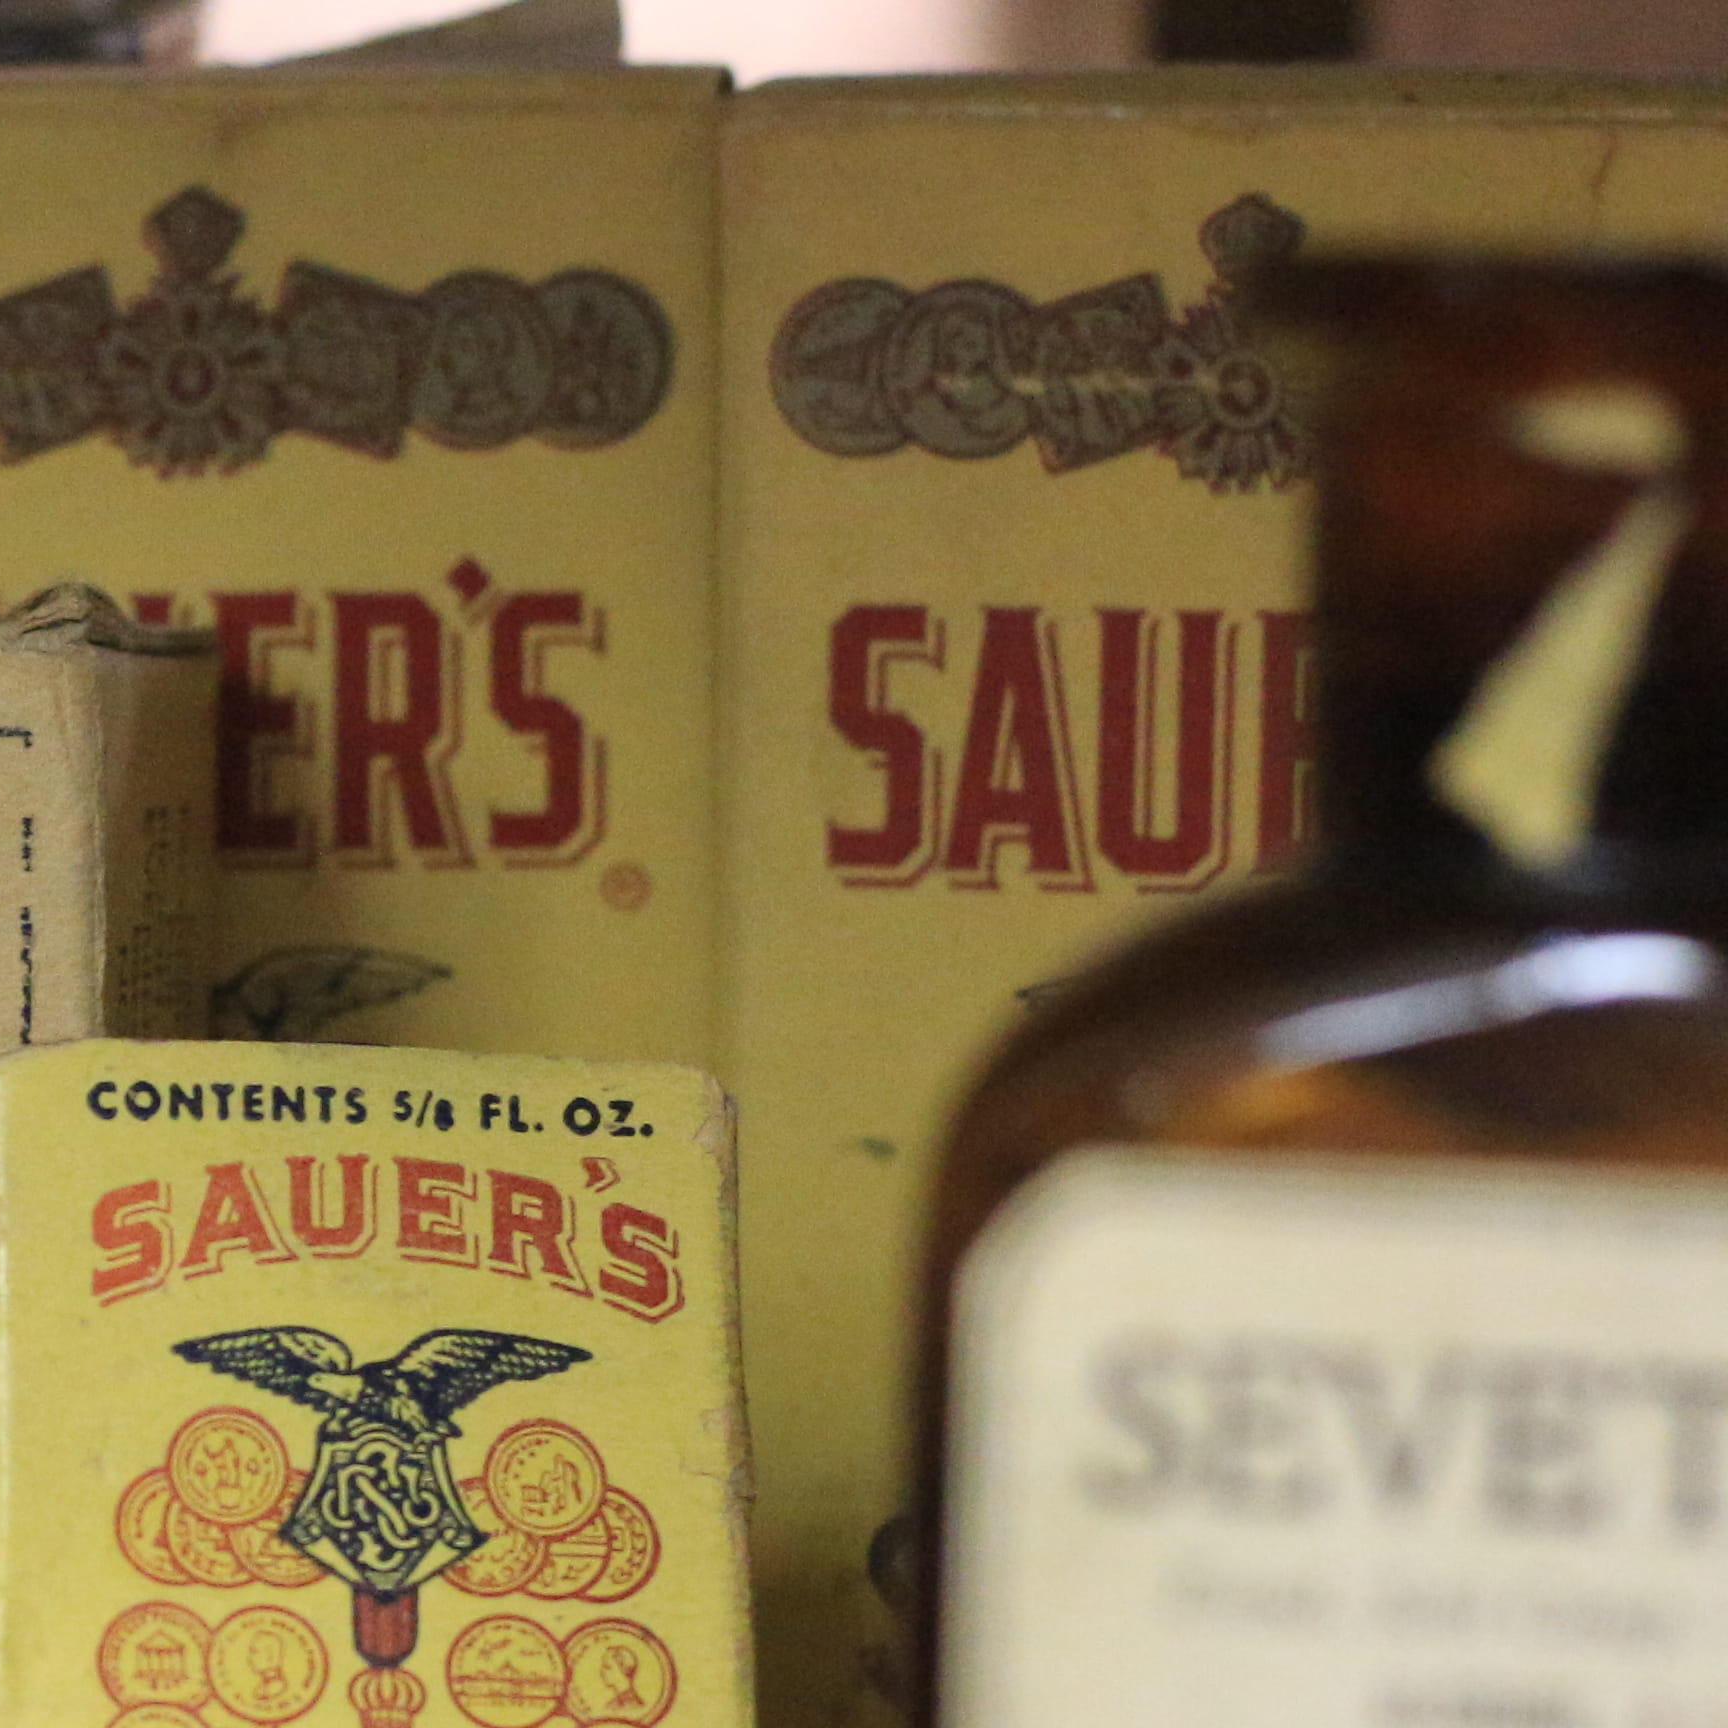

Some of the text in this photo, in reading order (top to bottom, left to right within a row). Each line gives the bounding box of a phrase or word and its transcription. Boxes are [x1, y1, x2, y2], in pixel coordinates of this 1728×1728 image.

[86, 1080, 654, 1138] CONTENTS 5/8 FL. OZ.
[90, 1153, 686, 1324] SAUER'S
